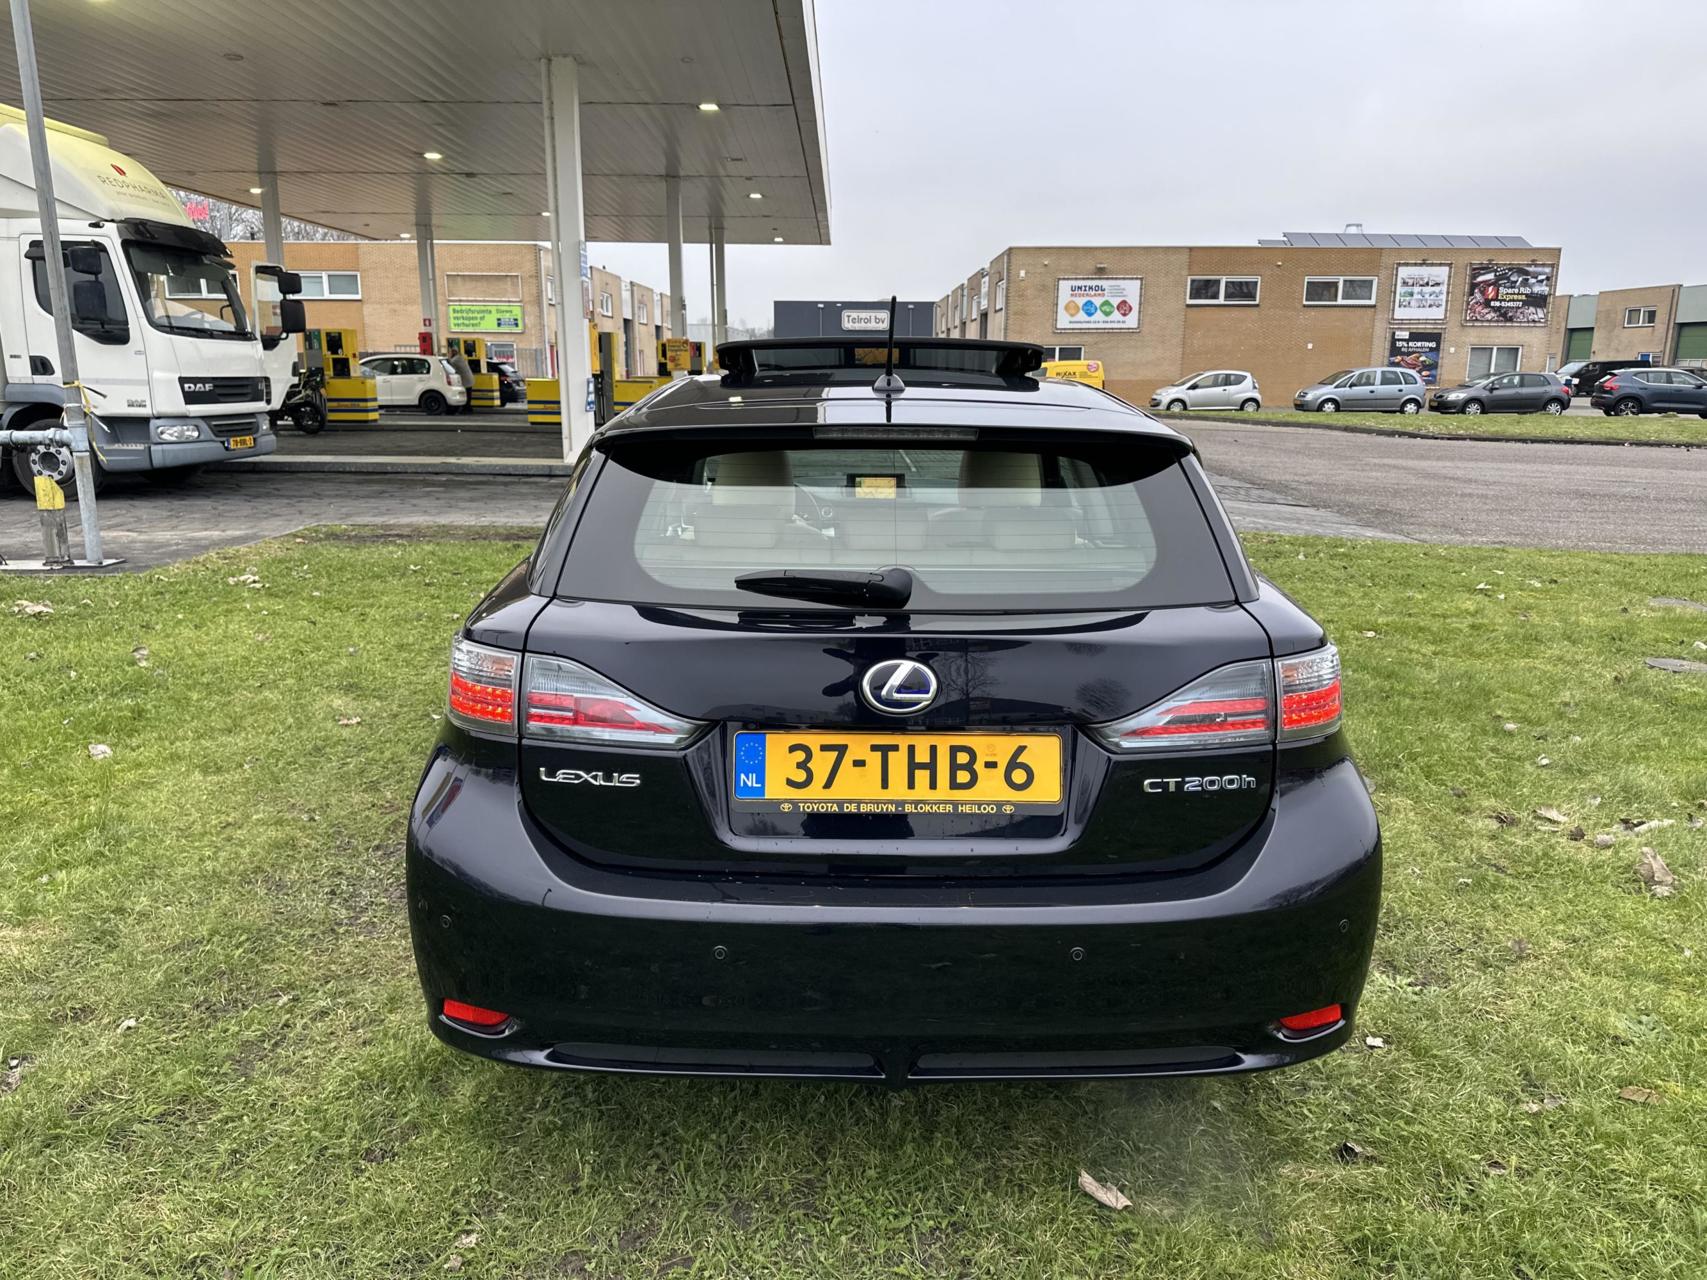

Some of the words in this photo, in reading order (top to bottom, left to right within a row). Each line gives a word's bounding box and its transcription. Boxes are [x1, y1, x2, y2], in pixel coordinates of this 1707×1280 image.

[874, 315, 886, 324] bv
[183, 383, 214, 392] DAF
[786, 743, 1035, 792] 37-THB-6
[539, 767, 641, 787] LEXUS
[740, 773, 762, 787] NL
[1143, 774, 1257, 792] CT200h
[798, 803, 839, 812] TOYOTA
[843, 803, 858, 812] DE
[860, 803, 896, 812] BRUYN
[904, 803, 953, 813] BLOKKER
[958, 804, 997, 813] HEILOO
